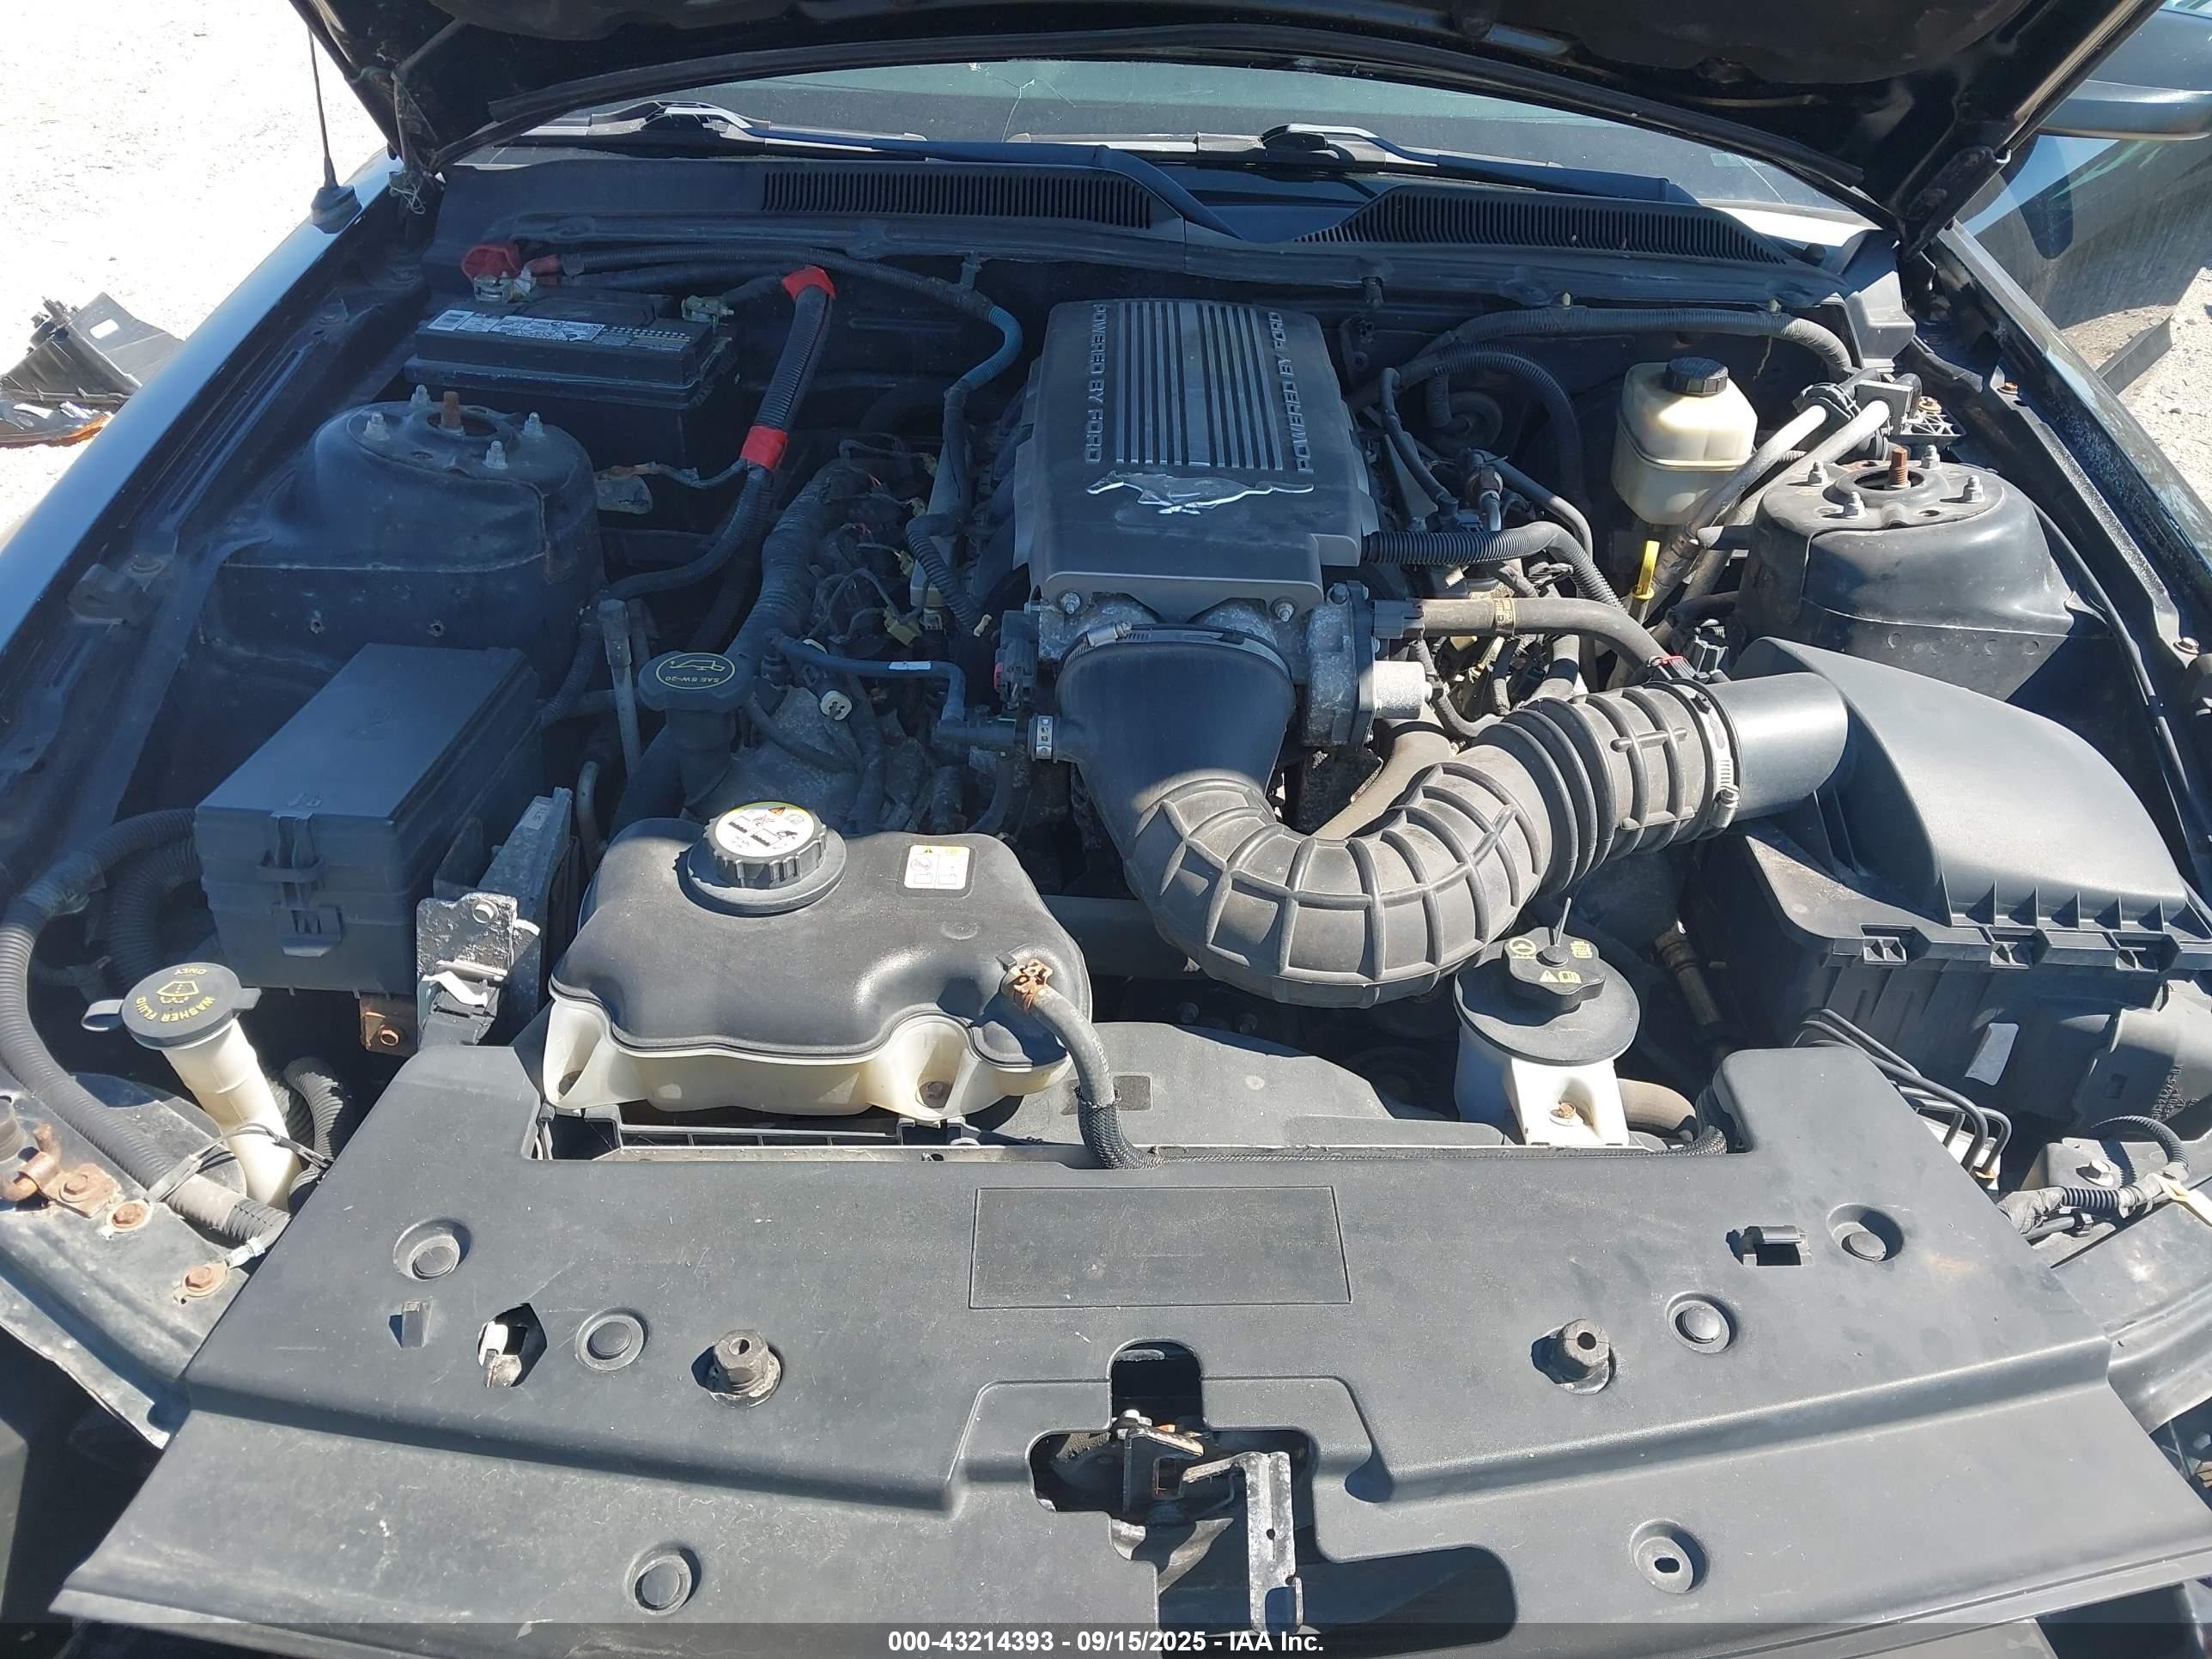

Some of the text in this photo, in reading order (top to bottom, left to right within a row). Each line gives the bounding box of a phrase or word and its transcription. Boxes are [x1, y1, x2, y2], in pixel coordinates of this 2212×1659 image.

[1085, 303, 1107, 465] POWERED BY FORD
[1267, 312, 1315, 473] POWERED BY FORD
[136, 995, 216, 1023] WASHER FLUID
[173, 967, 208, 975] ONLY
